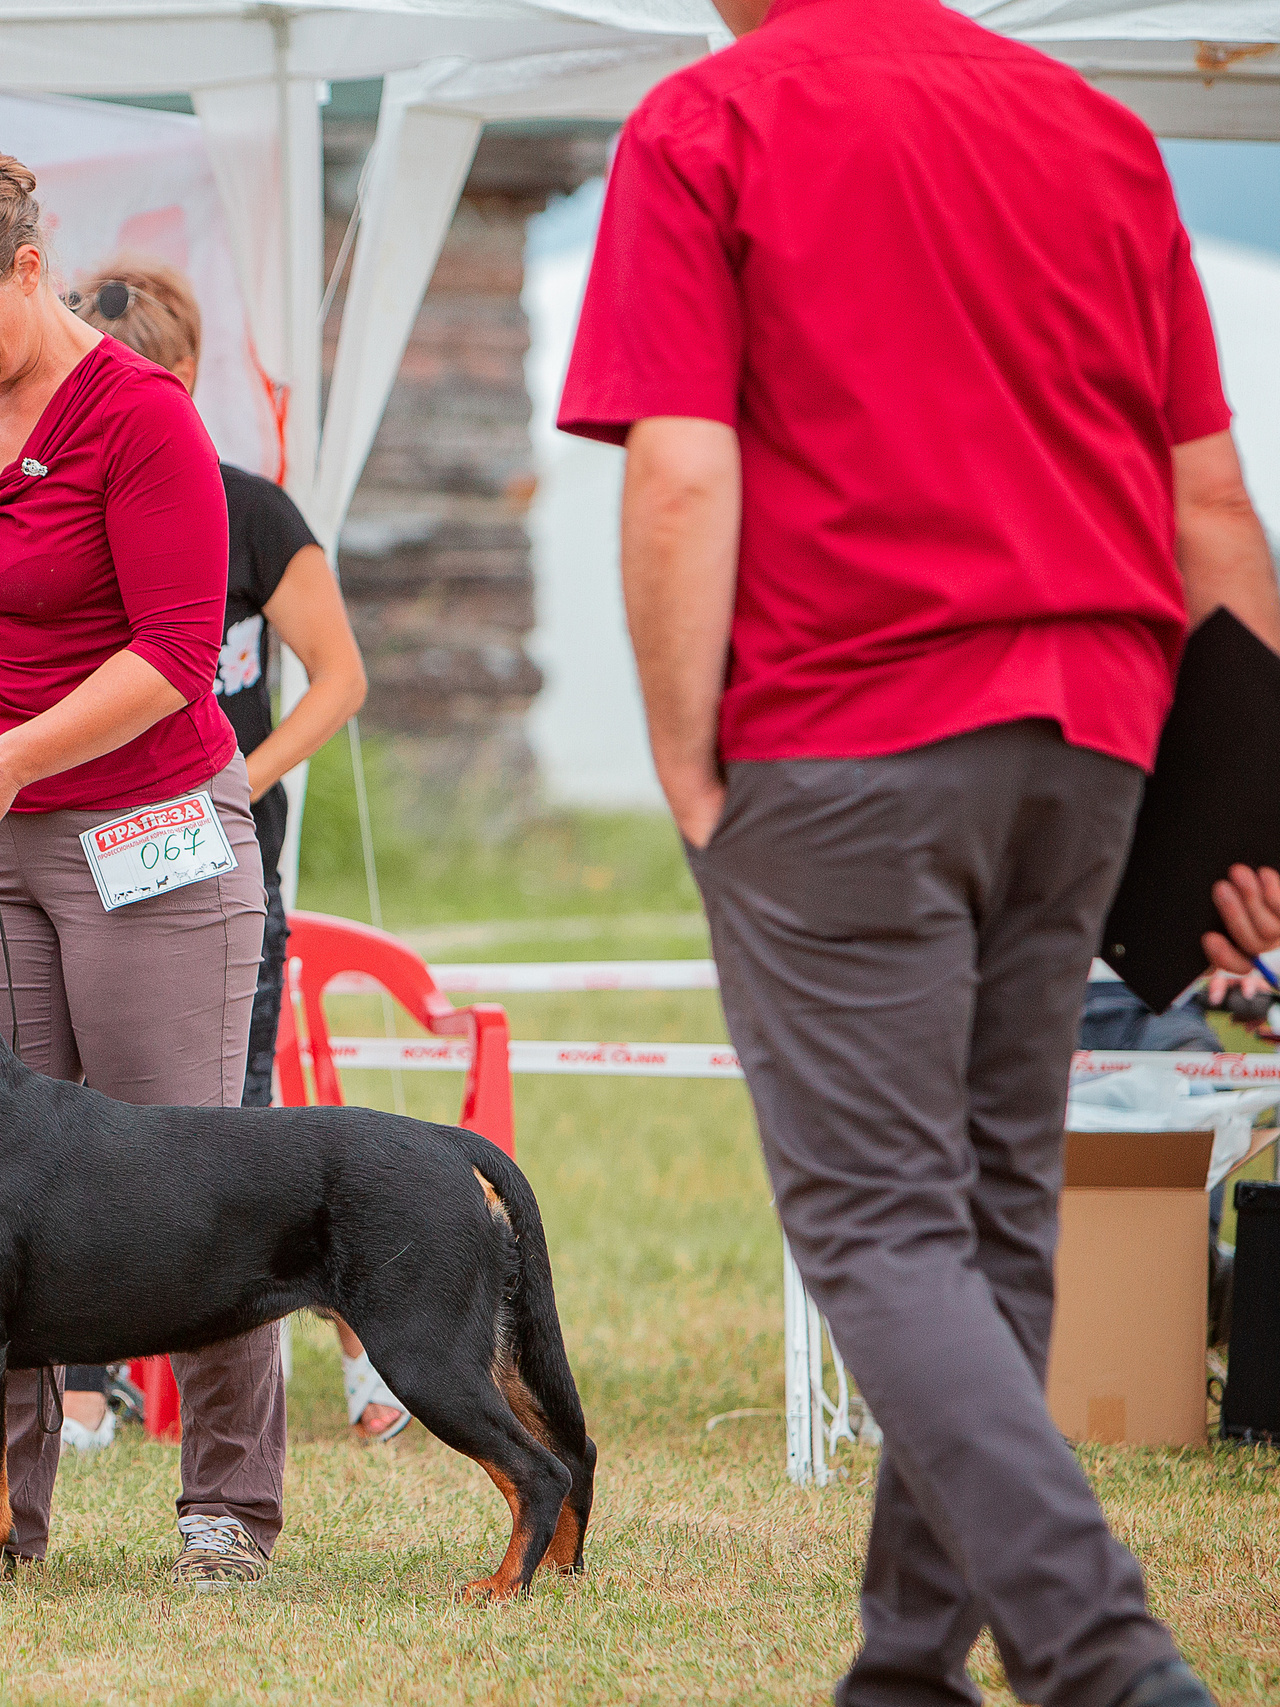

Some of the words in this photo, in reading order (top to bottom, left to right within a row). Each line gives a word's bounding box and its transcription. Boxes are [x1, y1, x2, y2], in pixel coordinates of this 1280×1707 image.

[96, 835, 150, 861] ПРОФЕССИОНАЛЬНЫЕ
[150, 830, 167, 841] КОРМА
[98, 804, 202, 849] ТРАПЕЗА
[140, 827, 206, 870] 067
